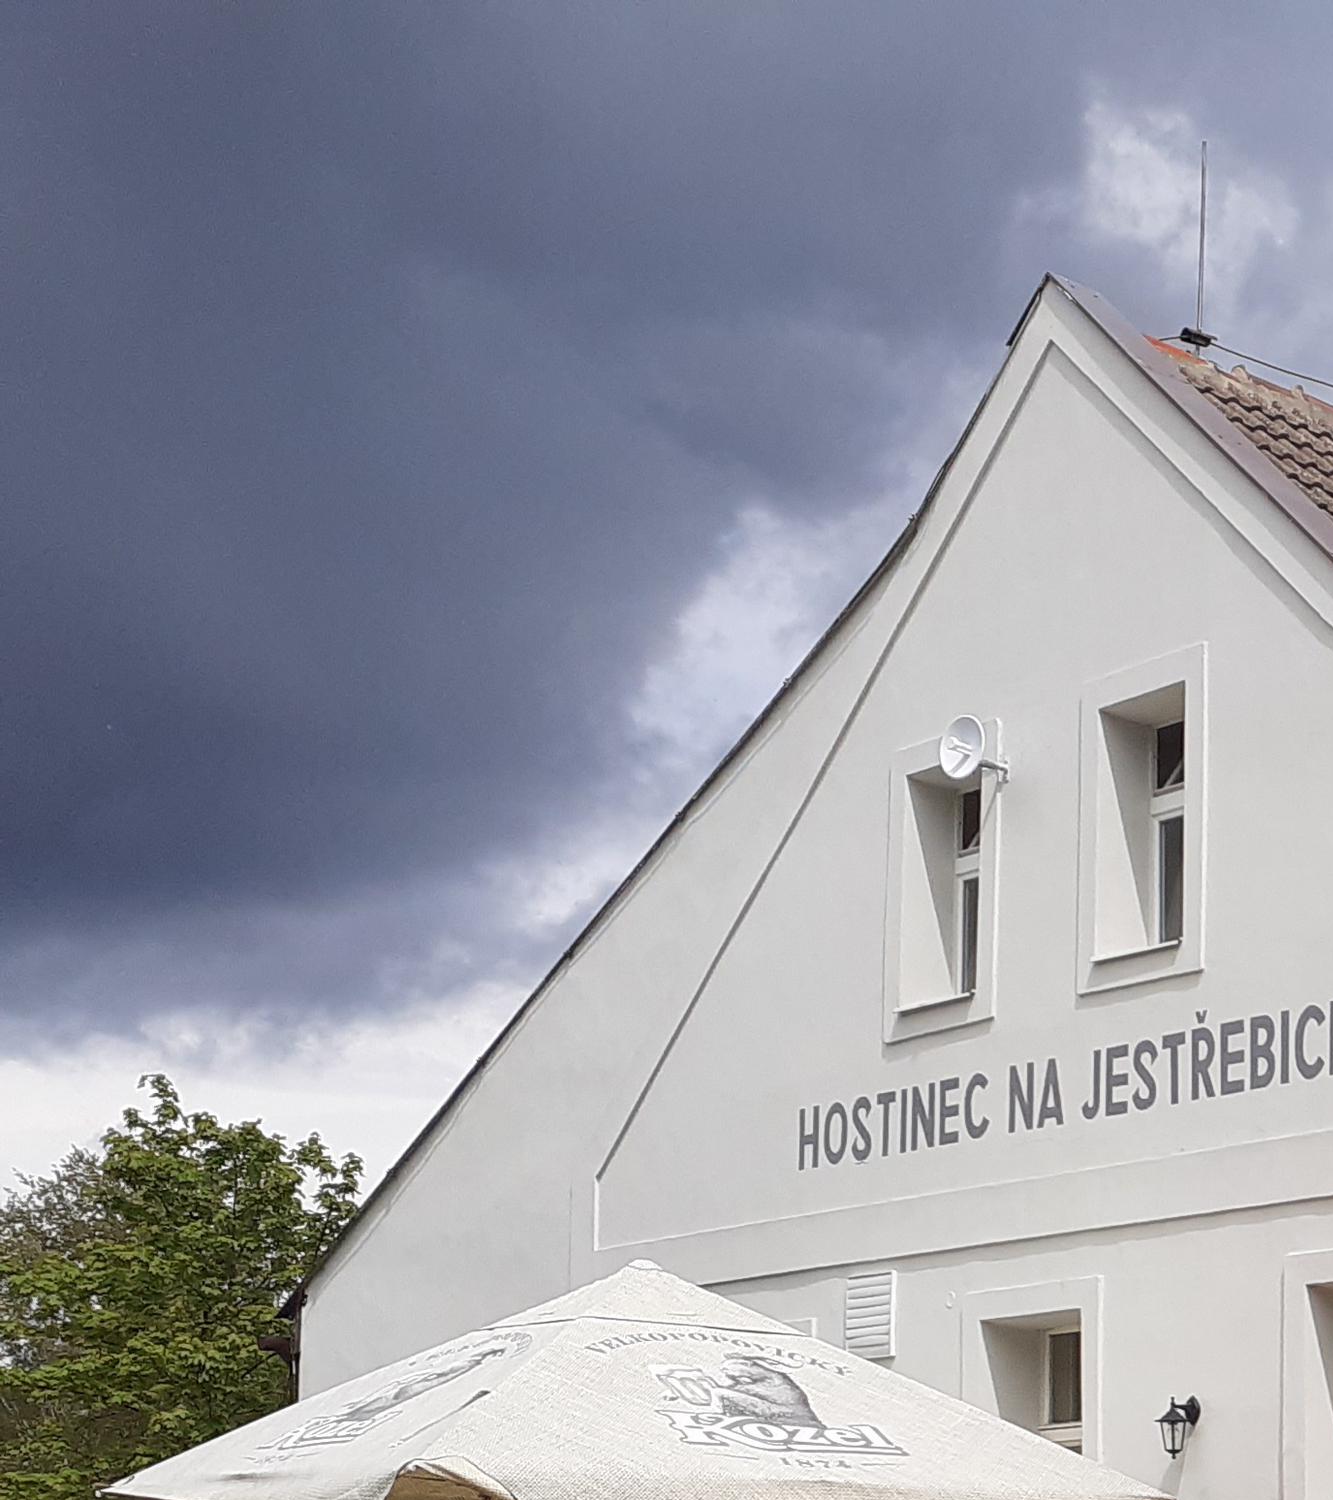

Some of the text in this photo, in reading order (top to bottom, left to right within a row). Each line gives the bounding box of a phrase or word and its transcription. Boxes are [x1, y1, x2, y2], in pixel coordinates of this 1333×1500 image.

[799, 1072, 989, 1171] HOSTINEC
[1008, 1057, 1064, 1133] NA
[655, 1410, 910, 1456] Kozel
